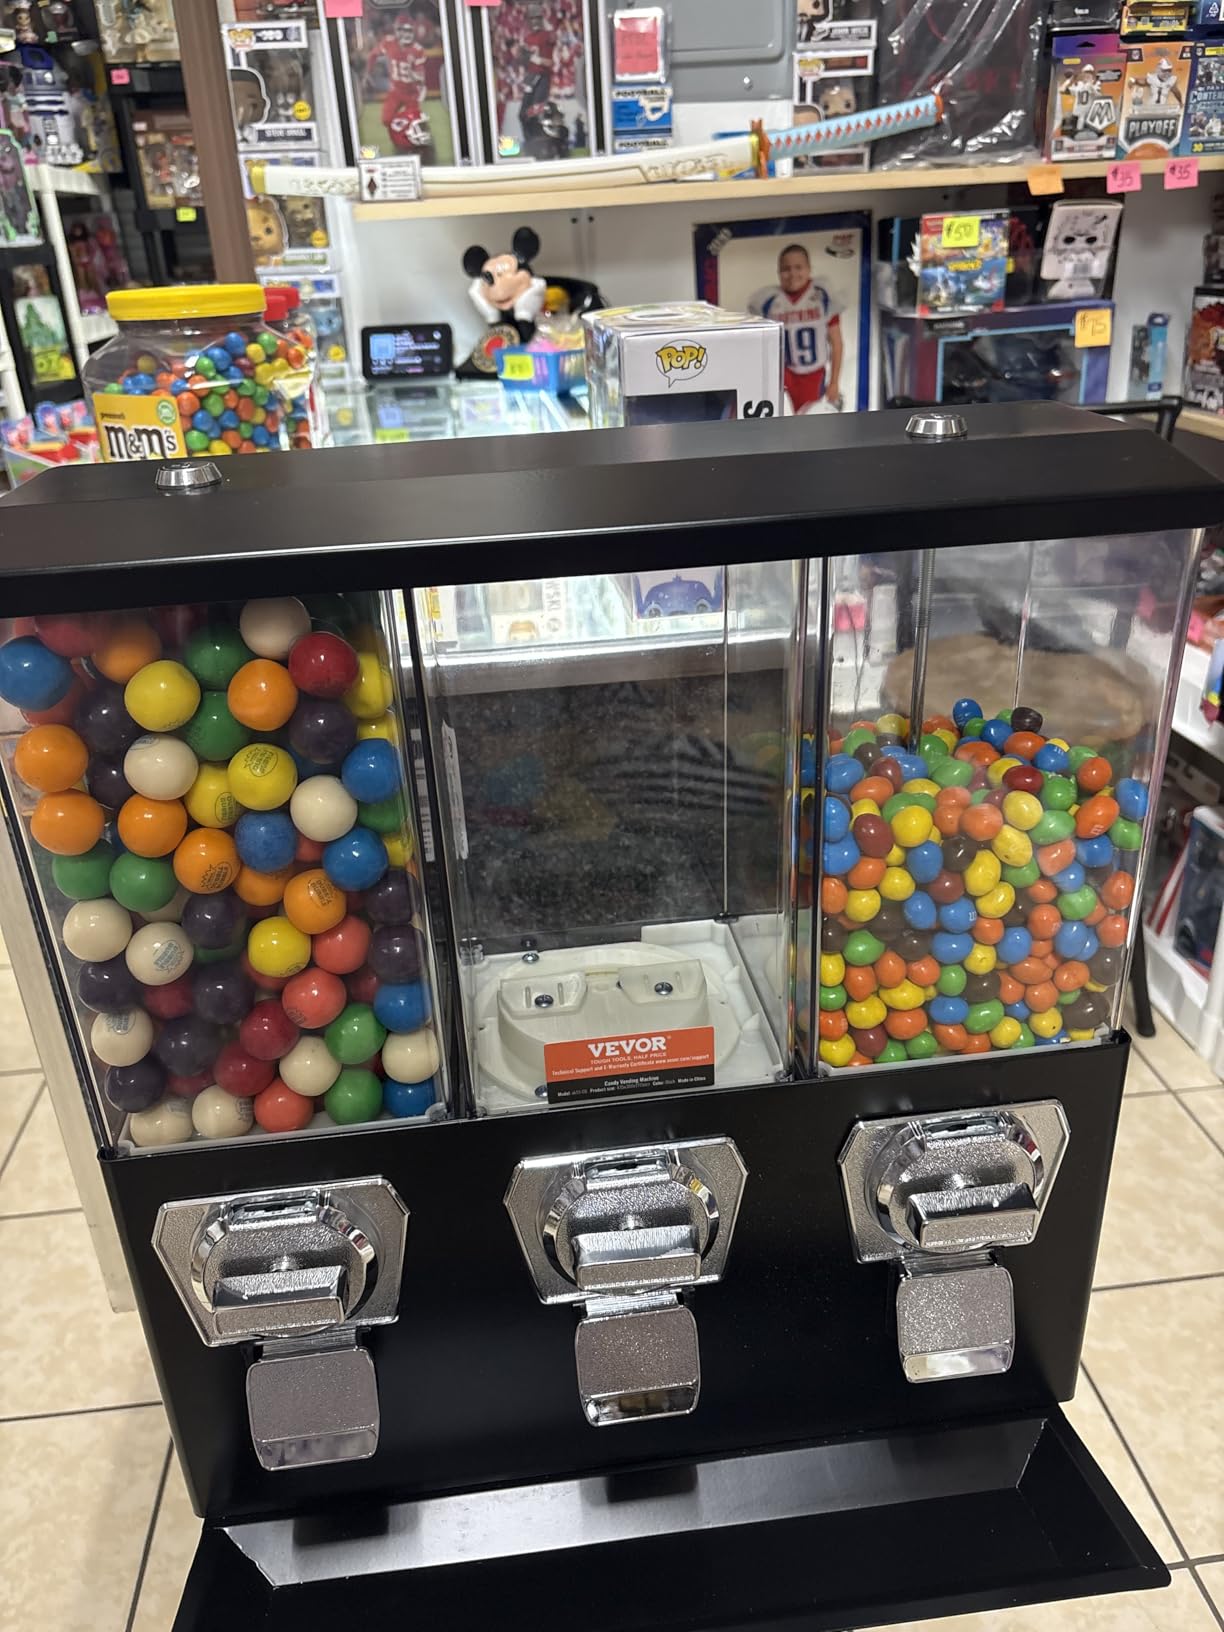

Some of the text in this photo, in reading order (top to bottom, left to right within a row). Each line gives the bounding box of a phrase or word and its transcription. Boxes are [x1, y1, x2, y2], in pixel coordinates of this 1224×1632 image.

[1129, 119, 1177, 137] PLAYOFF
[1169, 164, 1192, 181] $35
[655, 345, 706, 374] POP!
[587, 1036, 667, 1058] VEVOR
[591, 1057, 612, 1065] TOUGH
[604, 1079, 619, 1087] Candy
[620, 1077, 639, 1085] Vending
